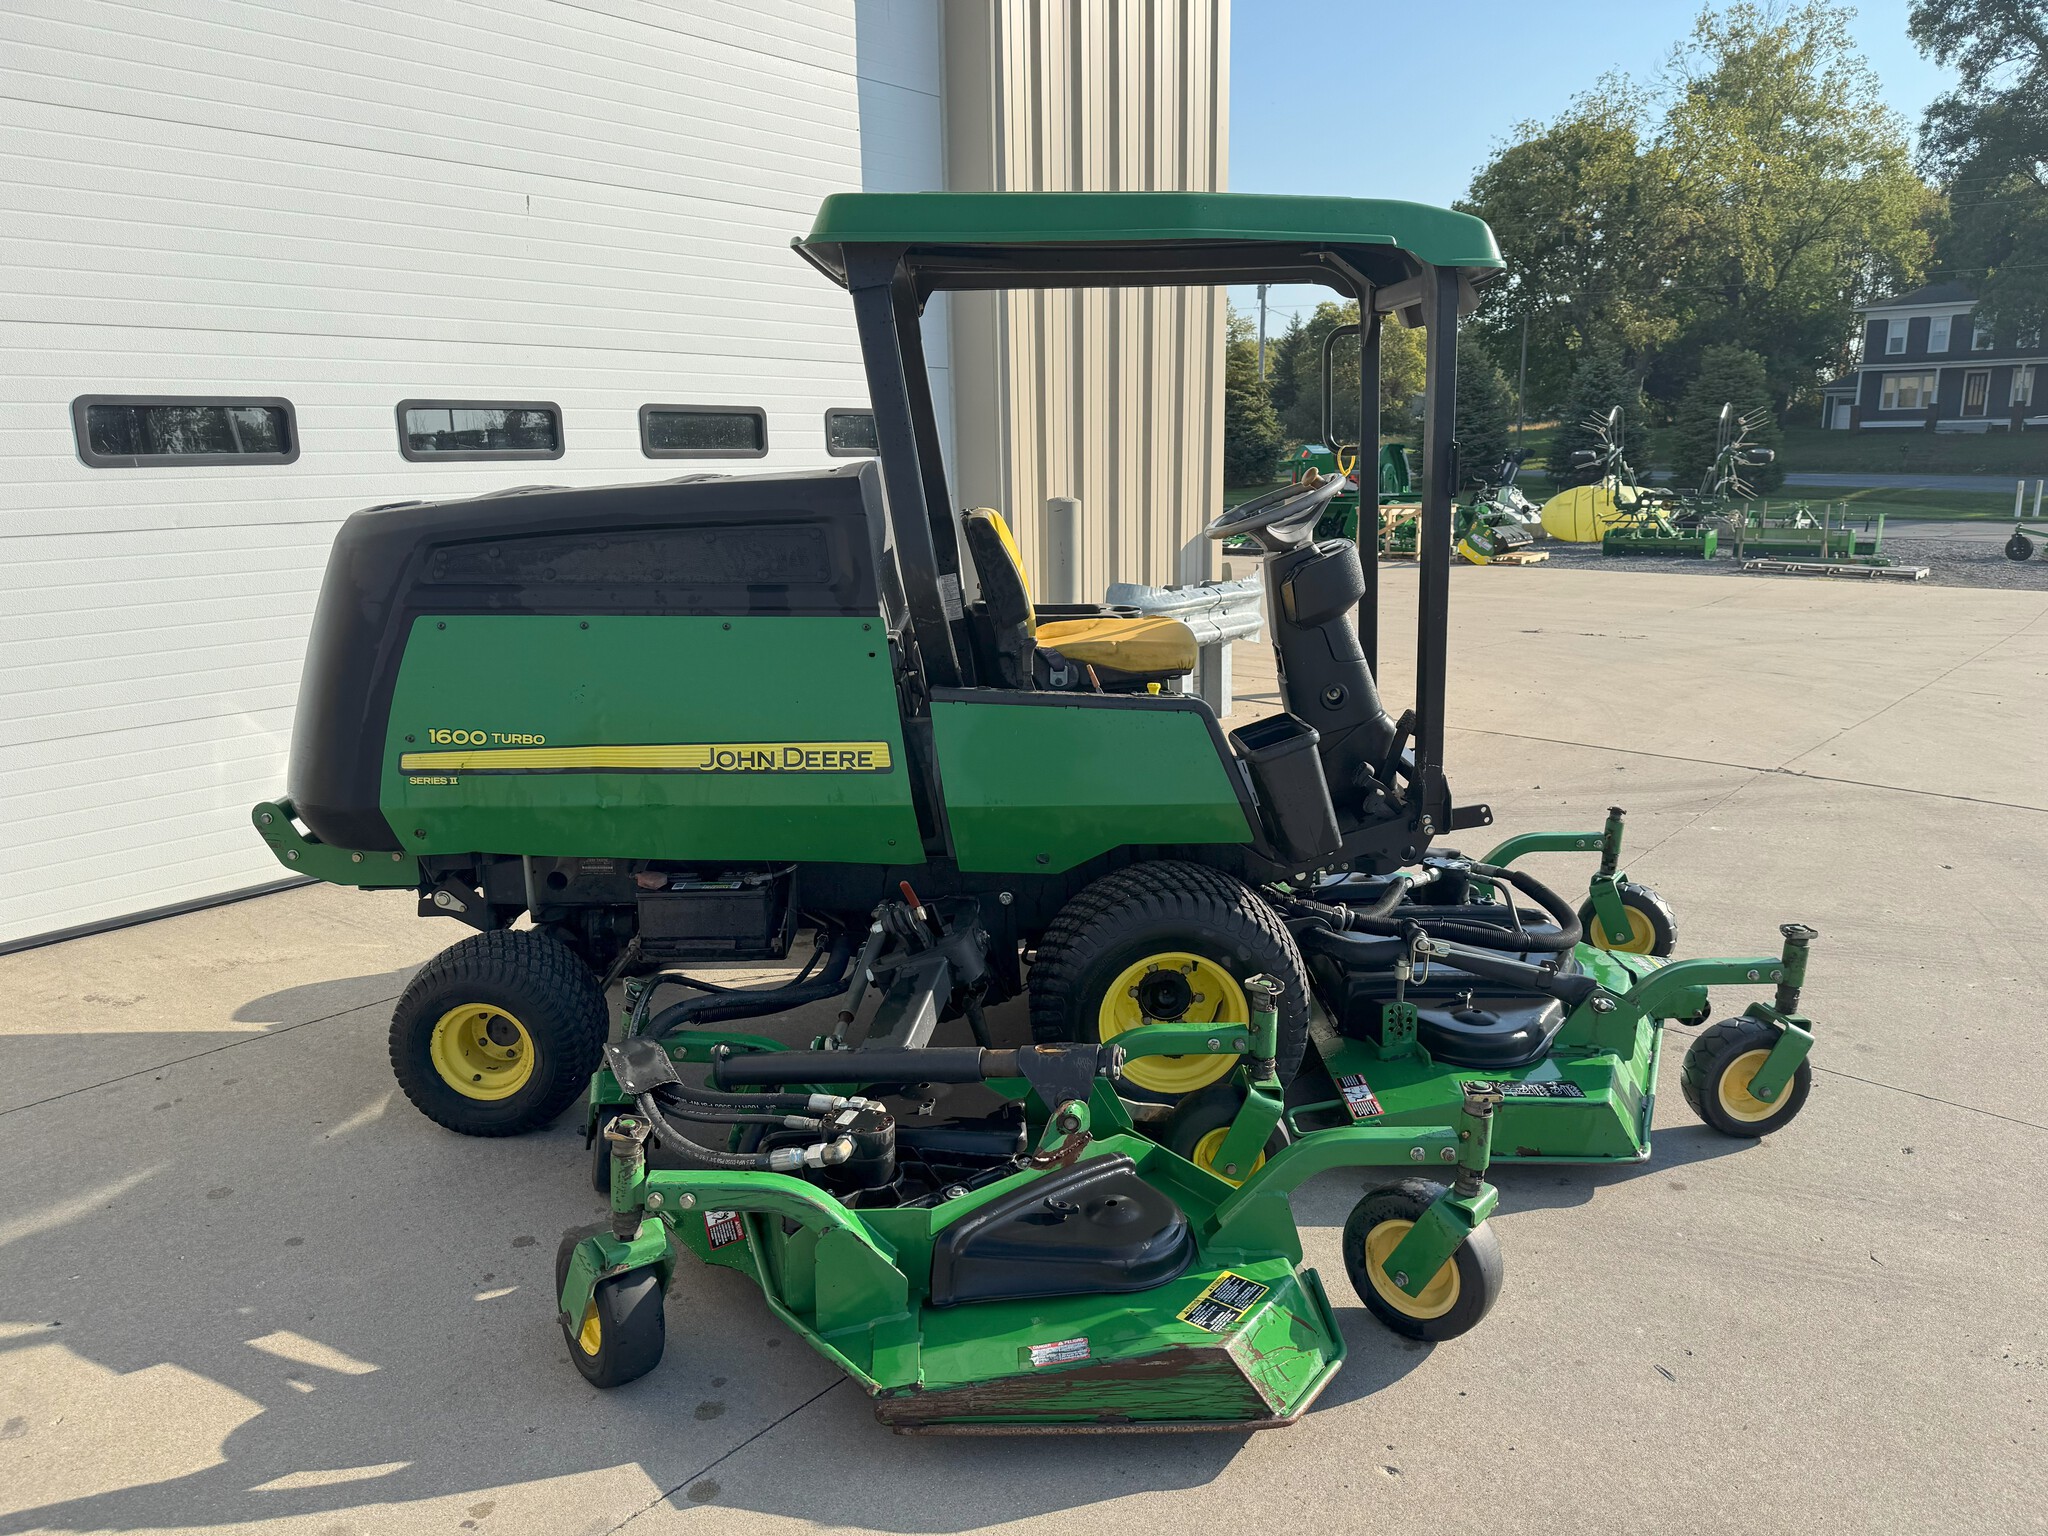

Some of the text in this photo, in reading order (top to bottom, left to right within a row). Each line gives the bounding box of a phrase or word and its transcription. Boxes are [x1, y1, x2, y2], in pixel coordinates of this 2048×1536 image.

[428, 728, 546, 746] 1600 TURBO
[700, 747, 876, 770] JOHN DEERE
[409, 776, 459, 786] SERIES II
